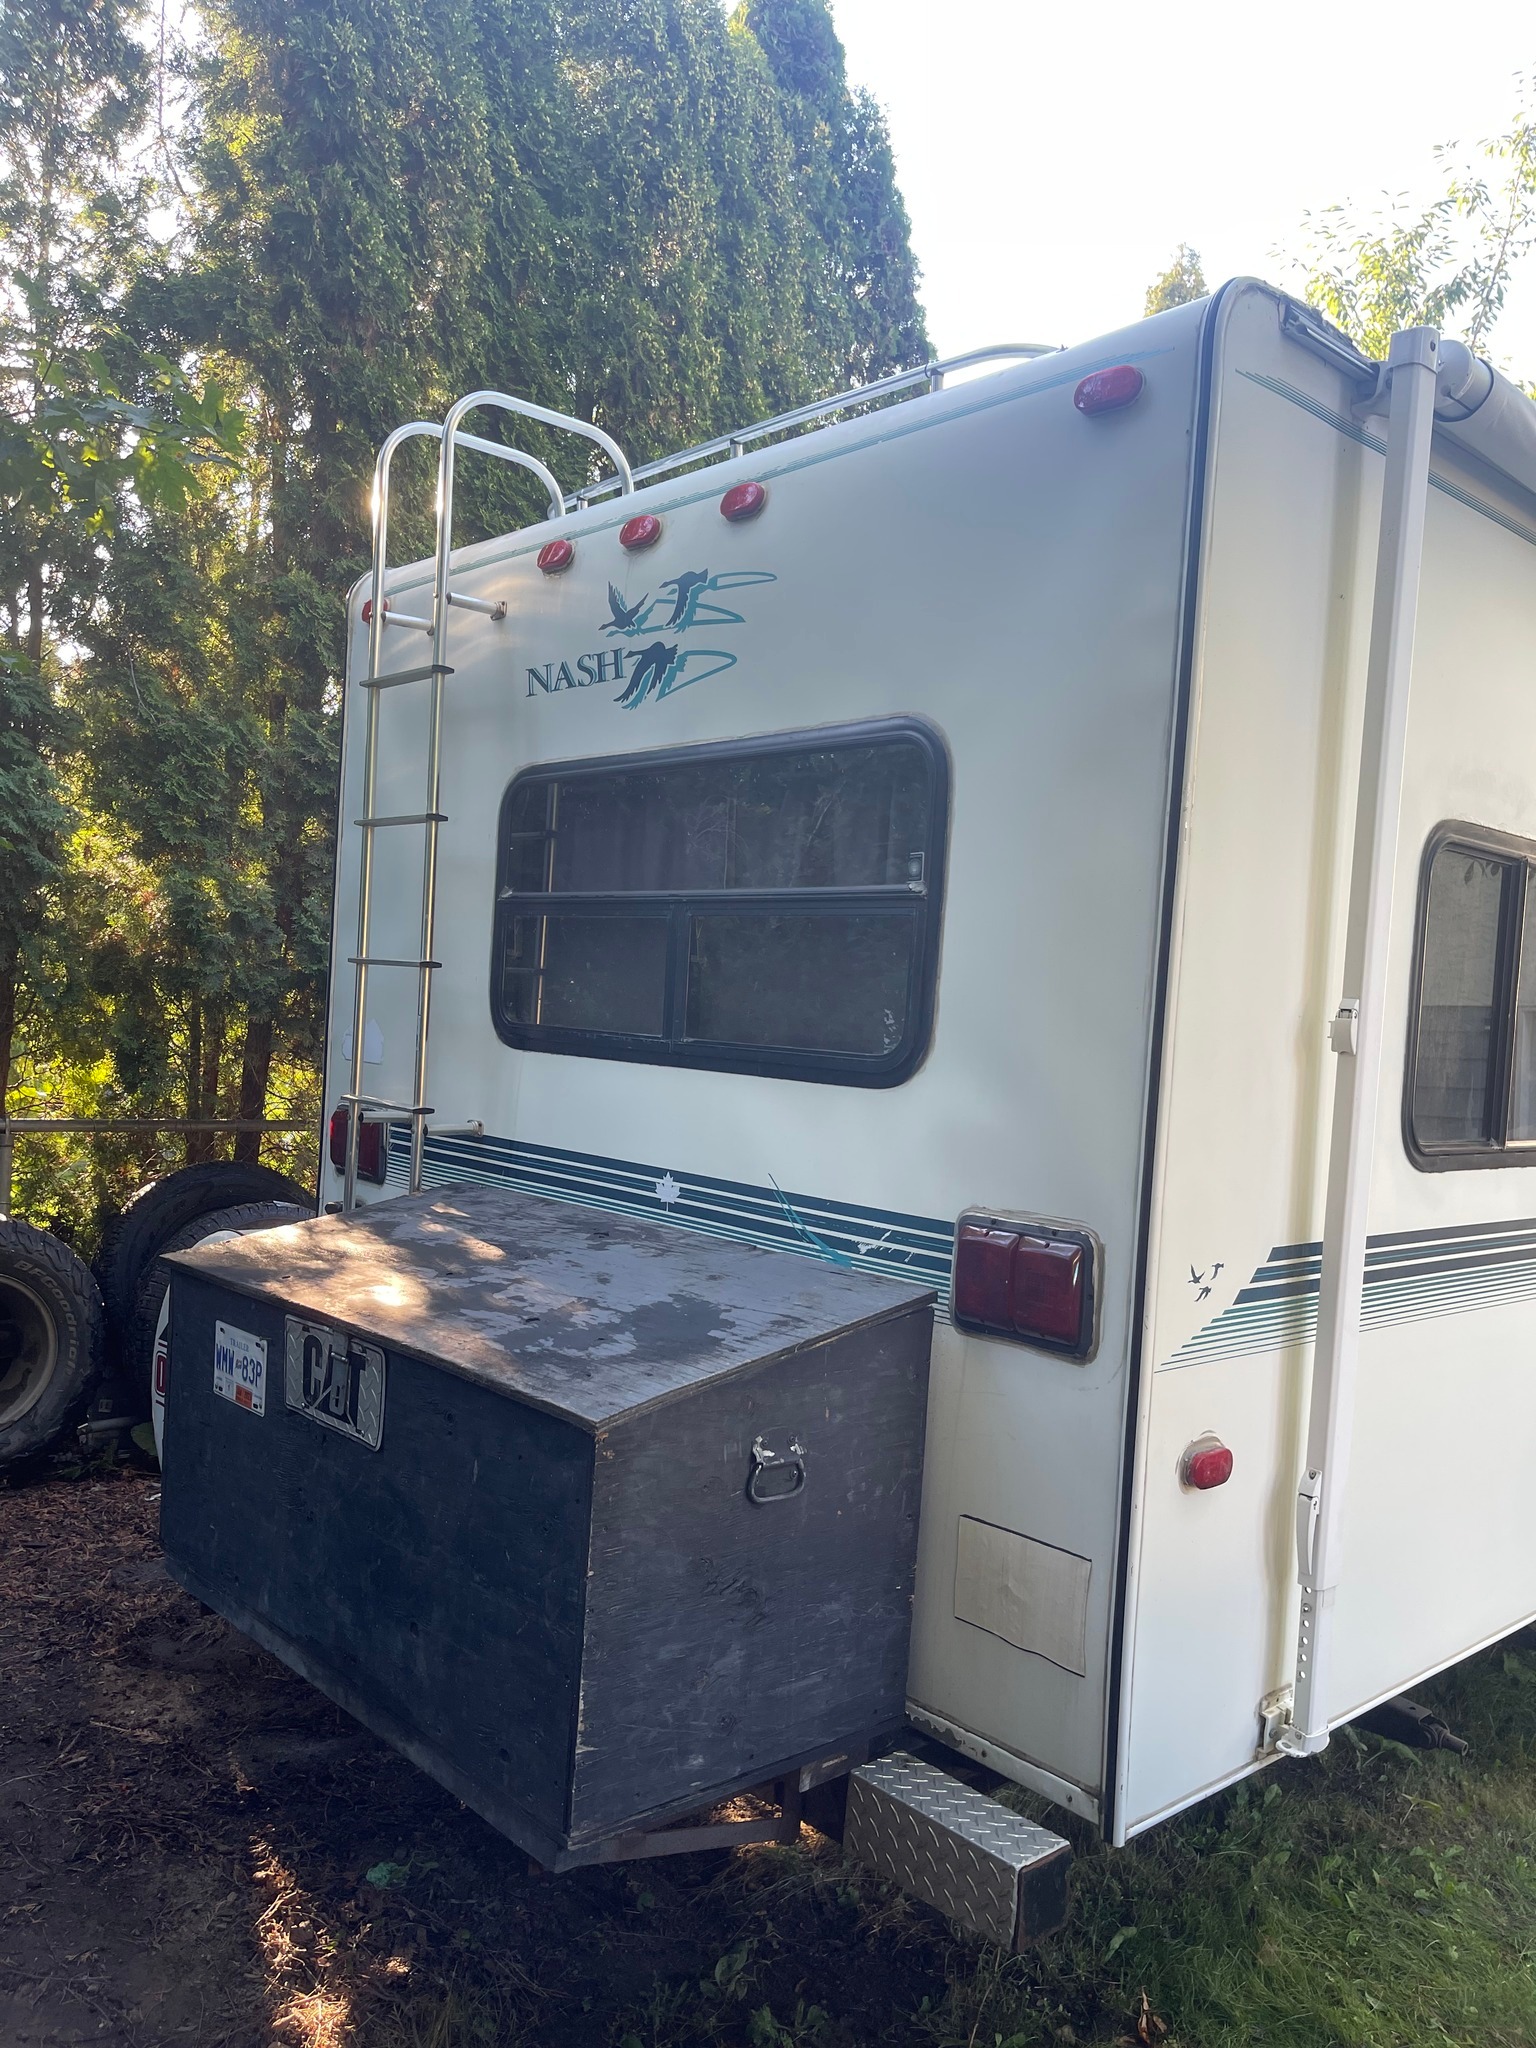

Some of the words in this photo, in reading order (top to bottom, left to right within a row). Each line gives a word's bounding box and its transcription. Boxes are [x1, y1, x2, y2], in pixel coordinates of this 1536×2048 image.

[525, 647, 627, 698] NASH
[14, 1260, 80, 1377] BFGoodrich
[229, 1337, 250, 1352] TRAILER
[242, 1355, 263, 1388] 83P
